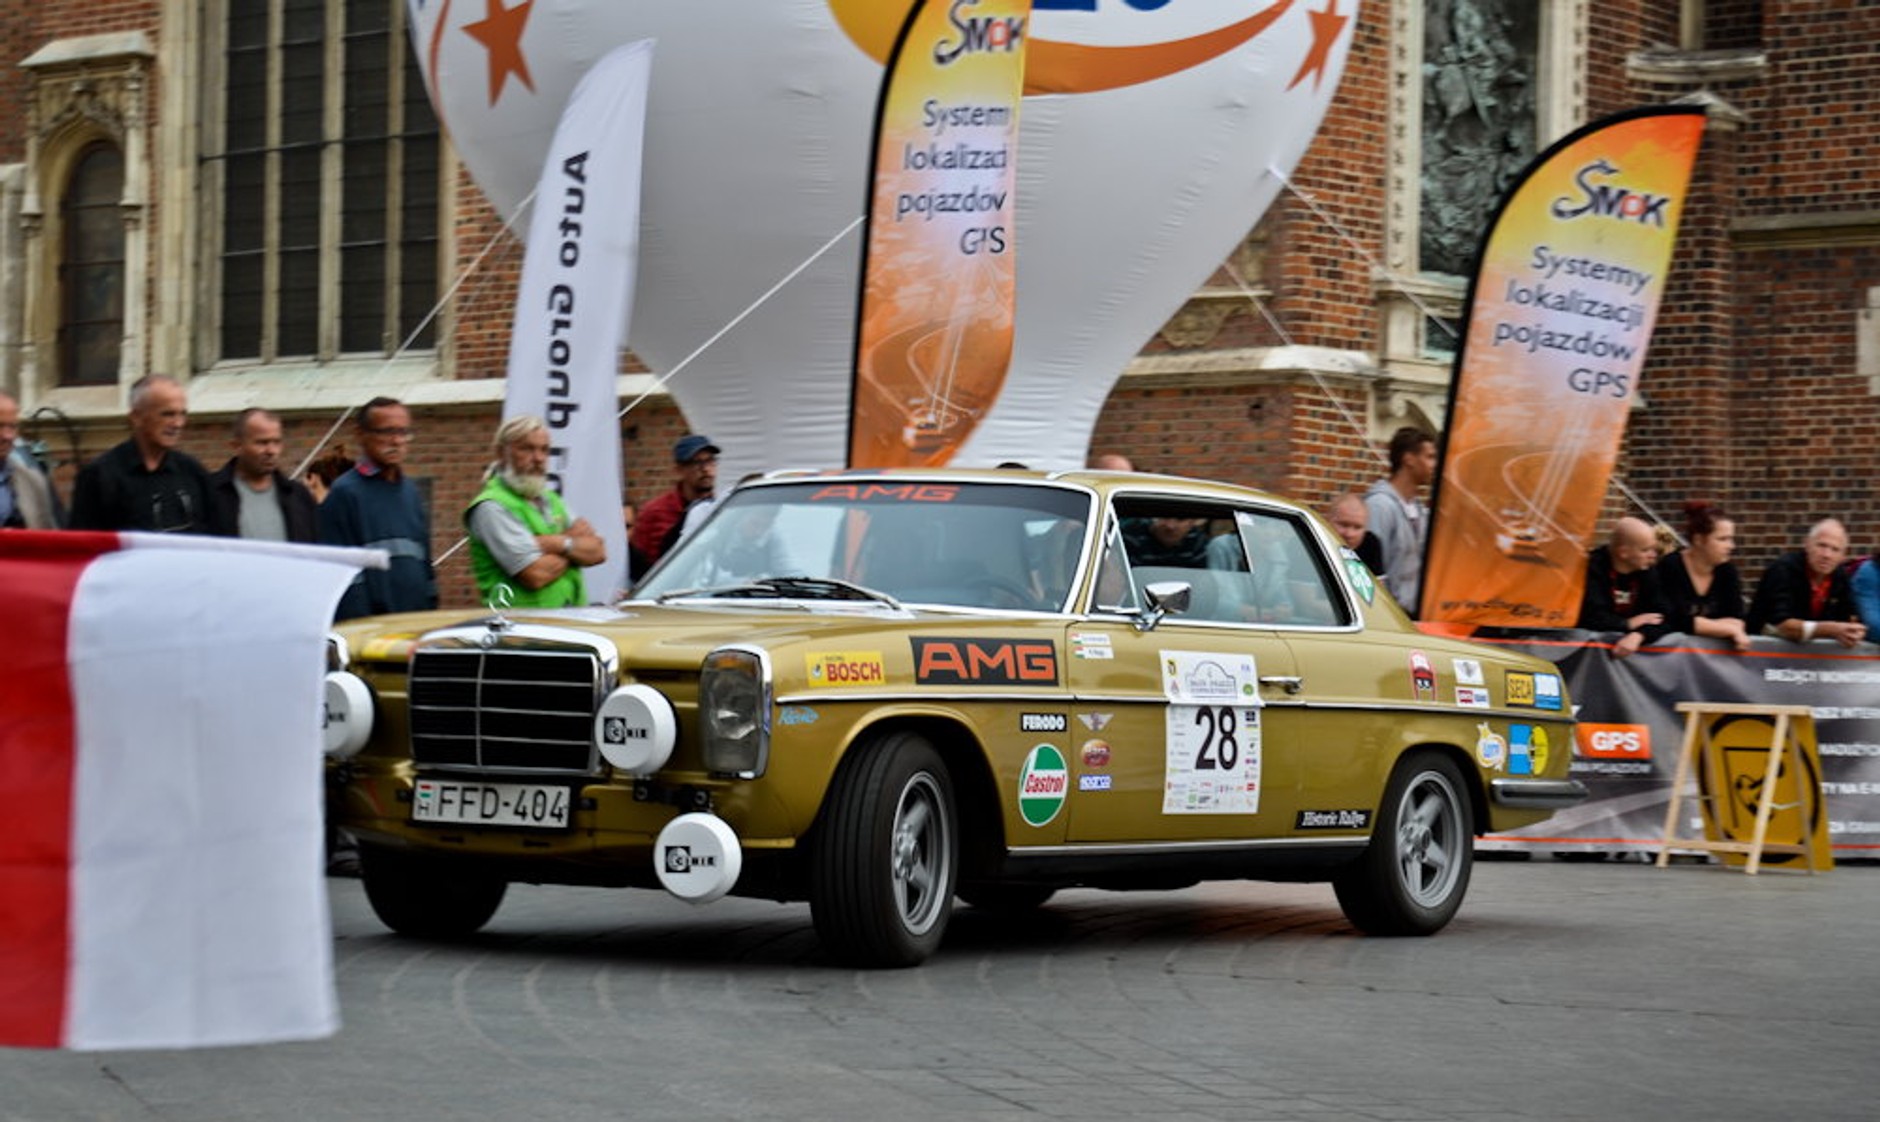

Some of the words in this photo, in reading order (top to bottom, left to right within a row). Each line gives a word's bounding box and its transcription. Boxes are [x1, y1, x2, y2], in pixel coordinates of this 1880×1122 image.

[1531, 246, 1652, 296] Systemy
[1505, 279, 1645, 332] lokalizacji
[1493, 322, 1637, 361] pojazdów
[1568, 367, 1631, 398] GPS
[811, 485, 961, 502] AMG
[826, 661, 882, 682] BOSCH
[918, 643, 1056, 680] AMG
[1022, 714, 1066, 731] FERODO
[1195, 705, 1239, 771] 28
[1591, 731, 1641, 752] GPS
[1024, 774, 1066, 793] Castrol
[438, 786, 564, 823] FFD-404
